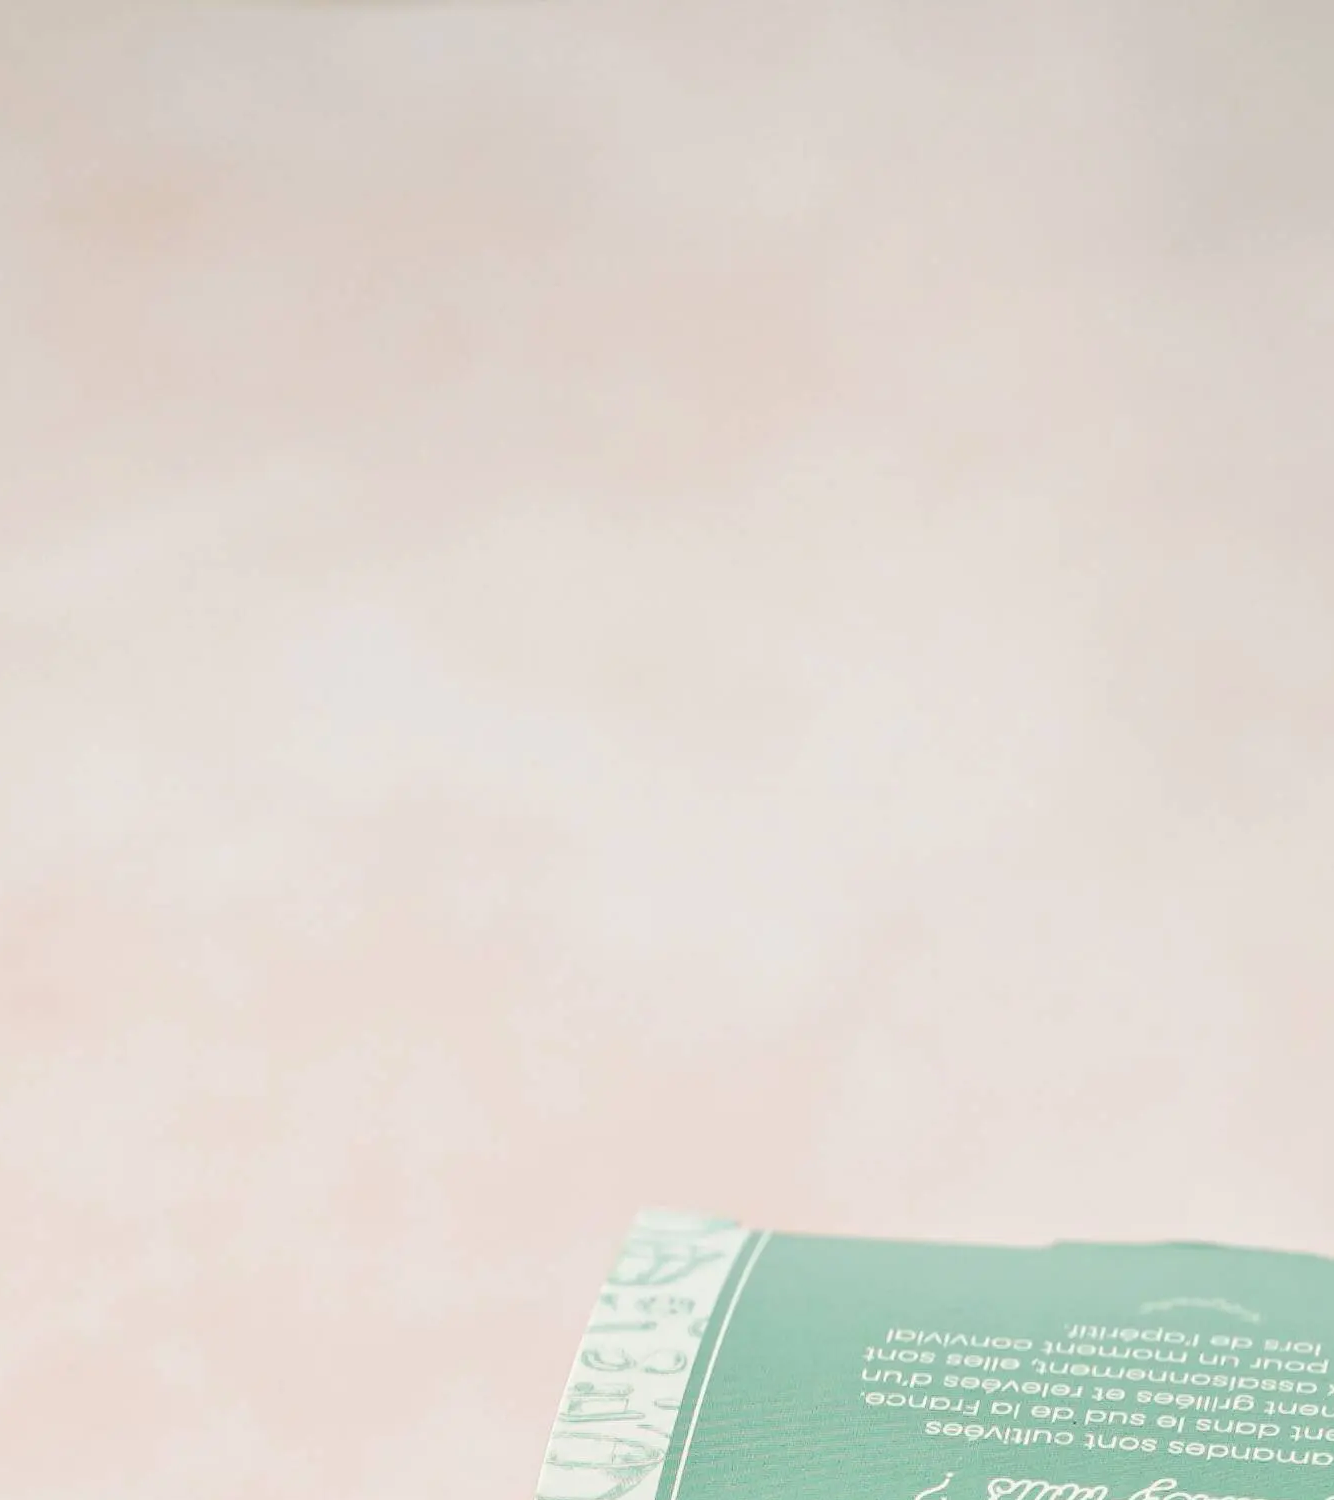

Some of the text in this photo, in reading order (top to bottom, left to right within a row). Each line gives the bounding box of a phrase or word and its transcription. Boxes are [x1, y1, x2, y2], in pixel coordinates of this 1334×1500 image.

[886, 1328, 1032, 1350] convivial
[1211, 1335, 1252, 1349] de
[1266, 1339, 1320, 1355] lors
[863, 1346, 935, 1363] sont
[1045, 1340, 1186, 1363] moment
[1200, 1353, 1238, 1366] un
[947, 1354, 1019, 1370] elles
[1251, 1357, 1328, 1373] pour
[944, 1374, 1082, 1397] relevées
[1094, 1387, 1125, 1401] et
[1138, 1391, 1254, 1411] grillées
[991, 1403, 1019, 1419] la
[1032, 1406, 1073, 1423] de
[1086, 1409, 1144, 1426] sud
[1157, 1416, 1185, 1432] le
[1197, 1419, 1280, 1438] dans
[926, 1421, 1073, 1446] cultivées
[1086, 1433, 1156, 1451] sont
[1168, 1441, 1333, 1465] amandes
